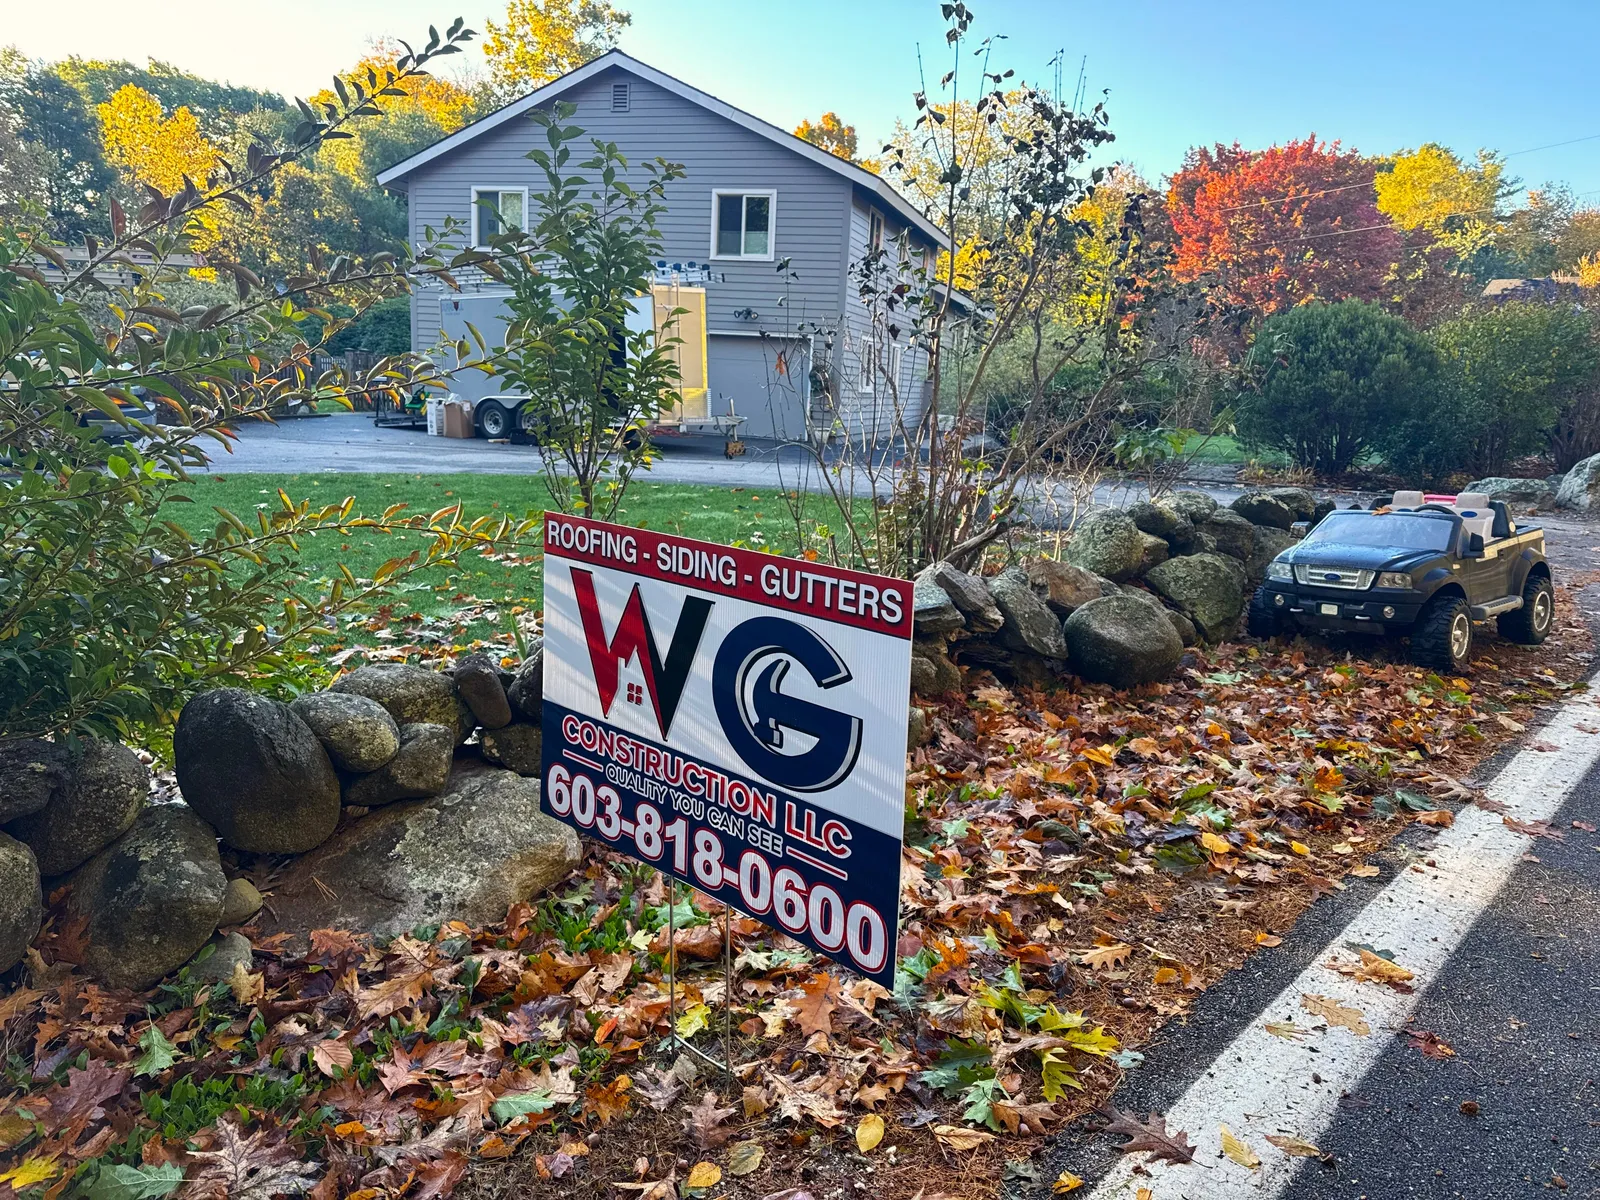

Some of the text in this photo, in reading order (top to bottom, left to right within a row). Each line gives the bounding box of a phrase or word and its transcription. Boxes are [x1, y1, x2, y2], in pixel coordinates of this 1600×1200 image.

[548, 520, 637, 564] ROOFING
[657, 542, 736, 586] SIDING
[760, 564, 903, 624] GUTTERS
[562, 714, 852, 859] CONSTRUCTION LLC
[605, 762, 783, 857] QUALITY YOU CAN SEE
[547, 762, 889, 974] 603-818-0600
